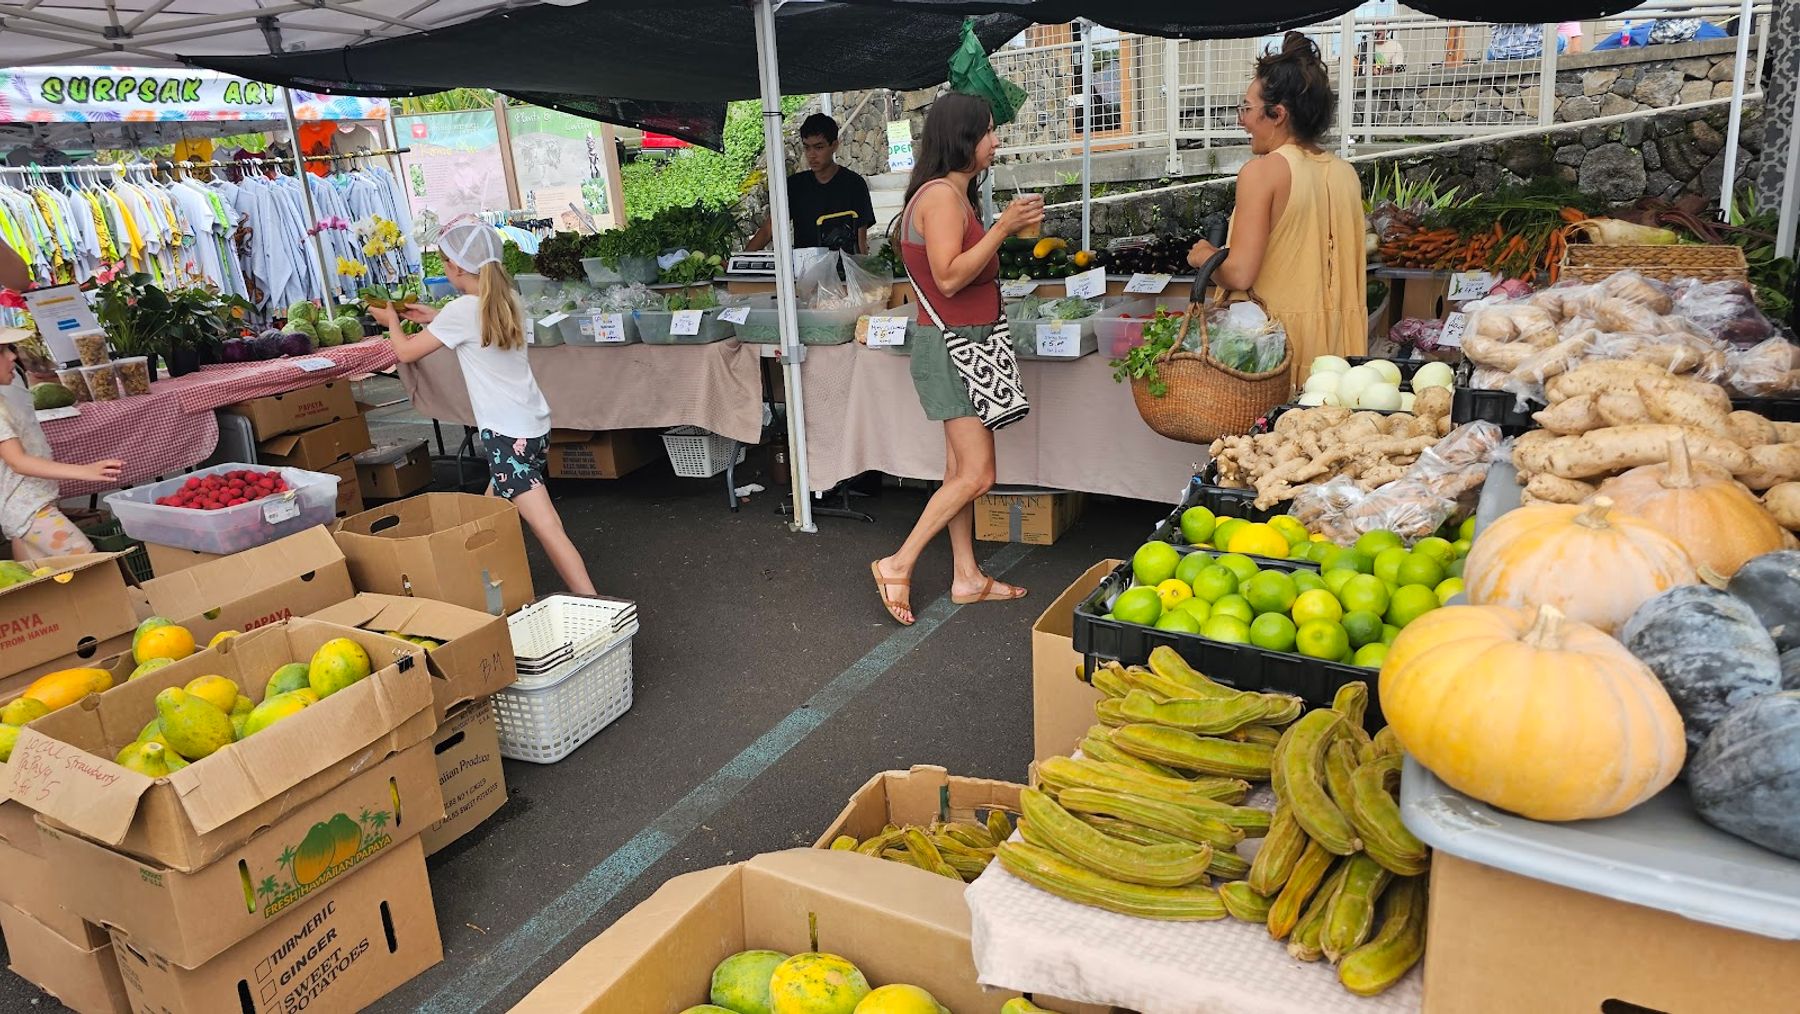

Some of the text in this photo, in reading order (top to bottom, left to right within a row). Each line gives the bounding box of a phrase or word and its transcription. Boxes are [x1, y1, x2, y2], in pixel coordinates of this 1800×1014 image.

[41, 76, 277, 105] SURPSAK ART
[0, 613, 44, 639] PAYA
[244, 607, 293, 633] PAPAYA
[0, 623, 60, 650] FROM HAWAII
[36, 780, 61, 801] 5
[439, 766, 460, 786] aiian
[264, 834, 392, 919] FRESH HAWAIIAN PAPAYA
[270, 900, 337, 966] TURMERIC
[280, 927, 338, 986] GINGER
[284, 947, 342, 1009] SWEET
[288, 937, 370, 1014] POTATOES
